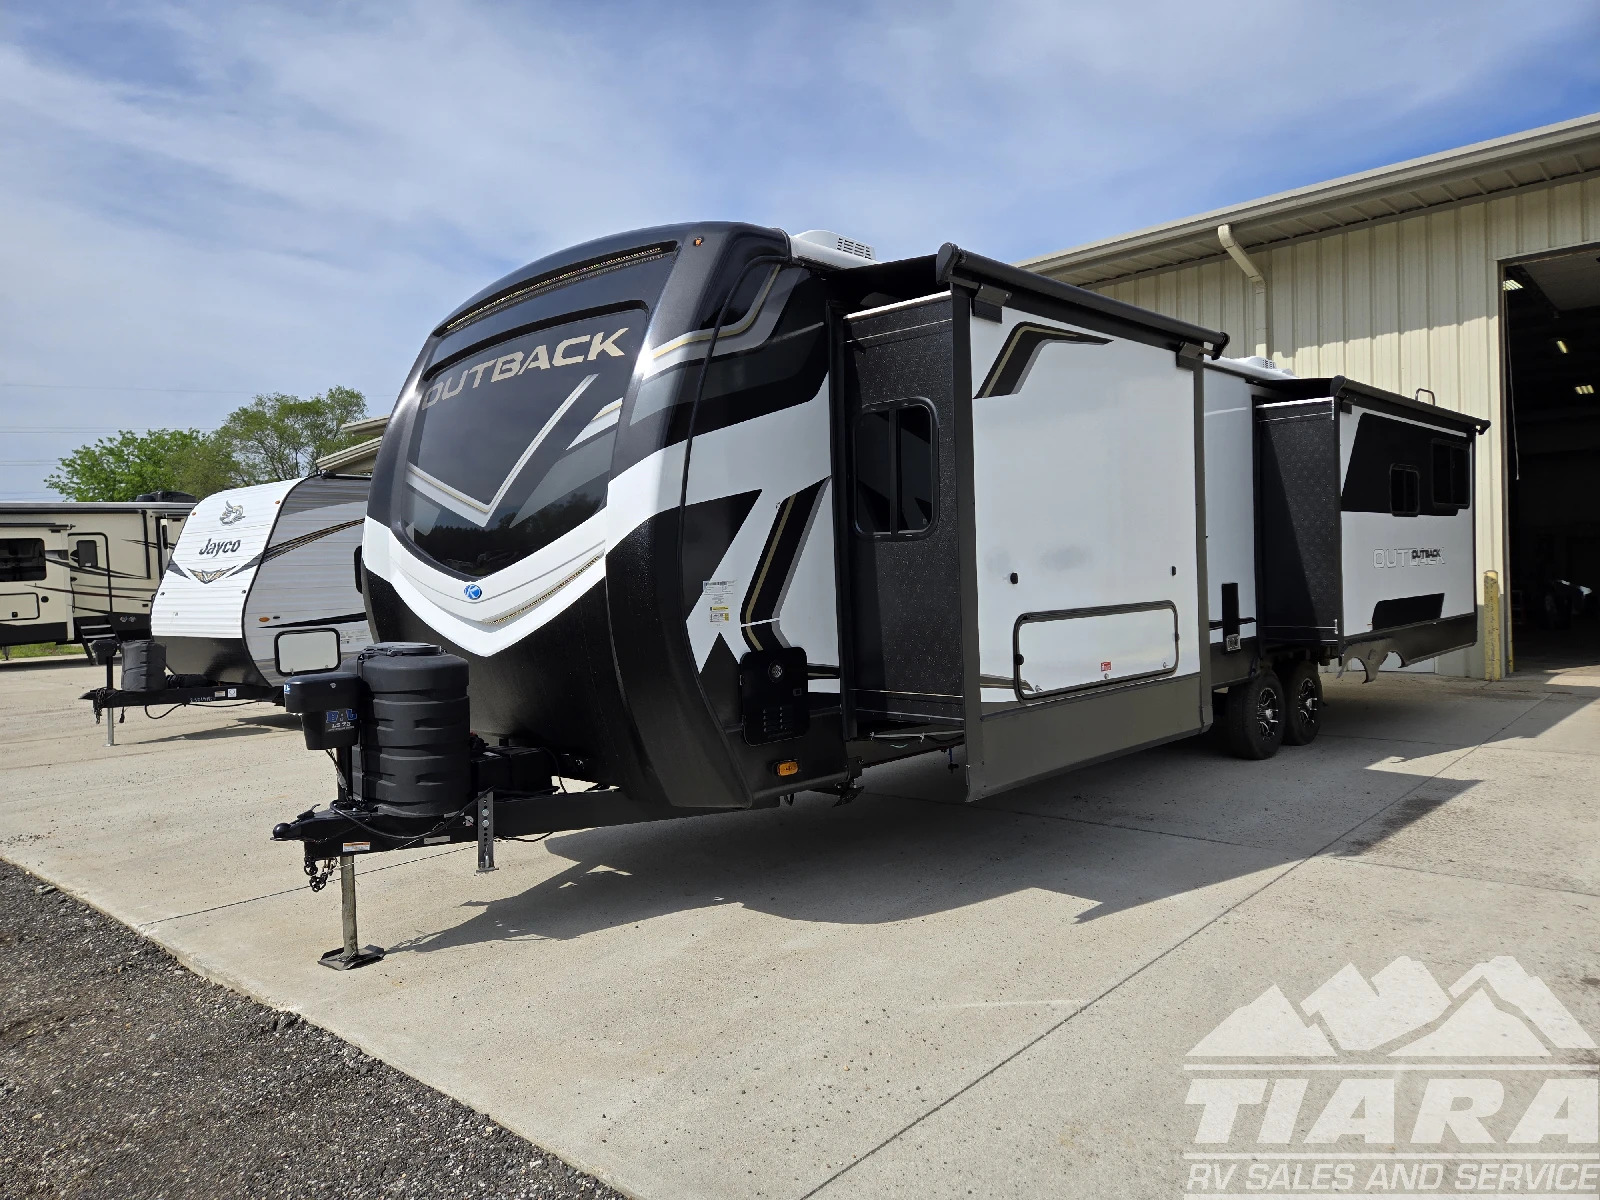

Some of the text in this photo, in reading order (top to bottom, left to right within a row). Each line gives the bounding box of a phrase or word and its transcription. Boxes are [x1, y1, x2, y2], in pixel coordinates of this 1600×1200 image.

[421, 327, 629, 411] OUTBACK
[198, 537, 242, 558] Jayco
[1411, 549, 1441, 559] OUTBACK
